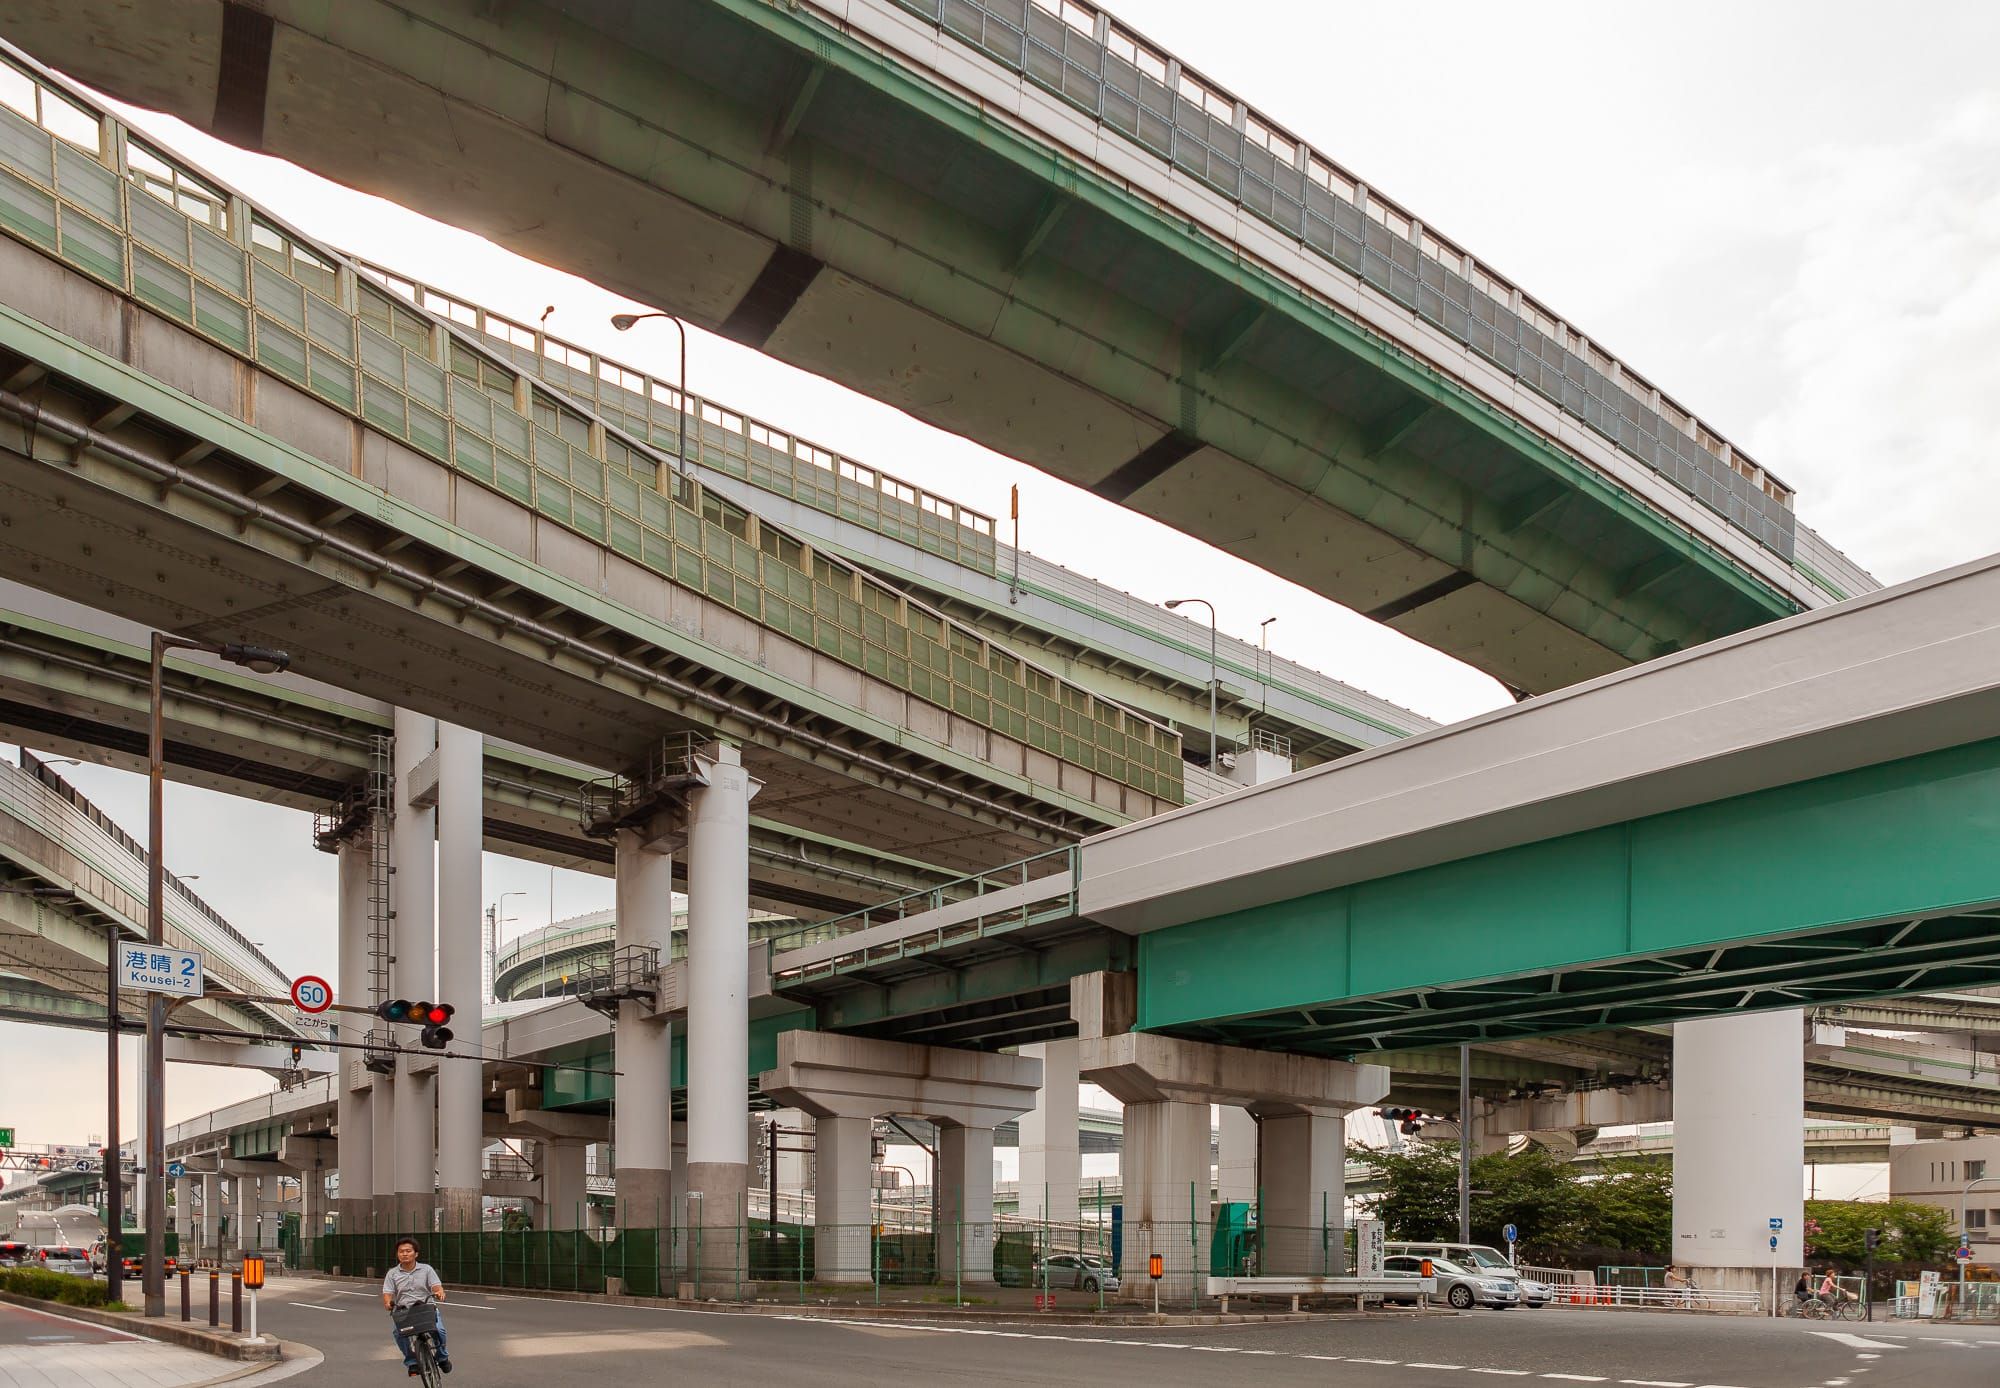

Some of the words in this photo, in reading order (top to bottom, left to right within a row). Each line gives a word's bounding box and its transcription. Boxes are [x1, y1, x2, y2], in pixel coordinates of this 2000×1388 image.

[125, 950, 172, 973] 港晴
[181, 957, 195, 977] 2
[131, 971, 191, 988] Kousei-2
[300, 985, 324, 1003] 50
[295, 1016, 329, 1028] ここから
